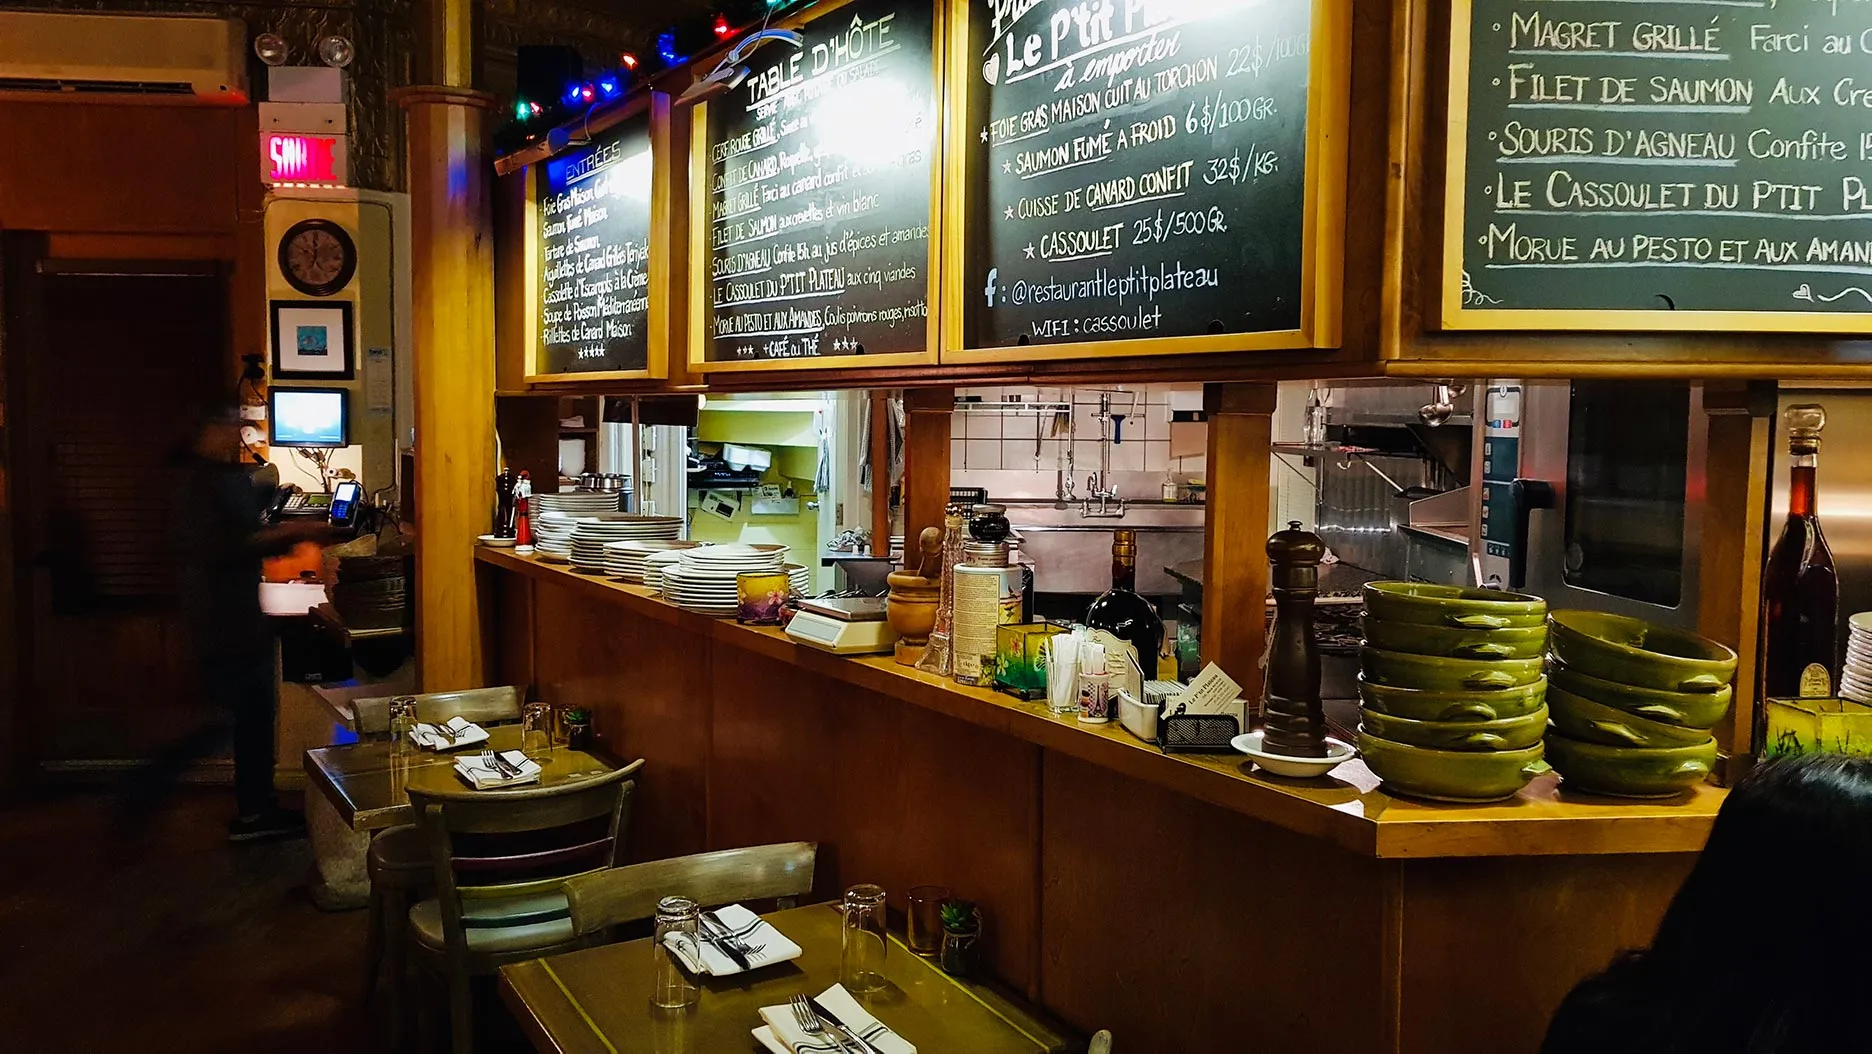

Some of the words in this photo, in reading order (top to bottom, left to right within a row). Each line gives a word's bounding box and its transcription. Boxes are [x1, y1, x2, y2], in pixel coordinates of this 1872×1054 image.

[1005, 32, 1042, 77] Le
[1509, 11, 1622, 51] MAGRET
[1631, 15, 1722, 52] GRILLÉ
[1750, 24, 1809, 53] Farci
[1822, 35, 1852, 55] au
[746, 52, 804, 104] TABLE
[811, 12, 896, 77] D'HÔTE
[1055, 61, 1076, 91] à
[1078, 31, 1181, 88] emporter
[991, 120, 1018, 142] FOIE
[1020, 103, 1050, 131] GRAS
[1051, 91, 1102, 124] MAISON
[1104, 78, 1134, 109] CUIT
[1134, 76, 1152, 102] AU
[1153, 54, 1218, 94] TORCHON
[1508, 62, 1591, 102] FILET
[1599, 77, 1638, 103] DE
[1649, 77, 1753, 106] SAUMON
[1769, 81, 1820, 106] Aux
[565, 140, 621, 181] ENTRÉES
[1015, 140, 1069, 175] SAUMON
[1073, 118, 1115, 161] FUMÉ
[1130, 113, 1177, 147] FROID
[1498, 119, 1594, 156] SOURIS
[1604, 129, 1736, 160] D'AGNEAU
[1747, 127, 1848, 162] Confite
[738, 164, 749, 183] DE
[1017, 193, 1059, 220] CUISSE
[1064, 187, 1083, 213] DE
[1085, 174, 1136, 210] CANARD
[1138, 160, 1194, 195] CONFIT
[1497, 171, 1532, 209] LE
[1545, 169, 1697, 212] CASSOULET
[1704, 183, 1740, 211] DU
[712, 226, 734, 248] FILET
[735, 221, 745, 242] DE
[836, 195, 851, 217] vin
[853, 188, 880, 213] blanc
[712, 254, 737, 277] SOURIS
[811, 244, 823, 259] au
[823, 236, 838, 263] jus
[839, 229, 877, 258] d'épices
[878, 225, 891, 247] et
[891, 218, 930, 244] amandes
[1040, 222, 1126, 260] CASSOULET
[1487, 221, 1579, 261] MORUE
[1590, 238, 1625, 262] AU
[1632, 234, 1713, 263] PESTO
[1719, 238, 1749, 262] ET
[1754, 238, 1799, 263] AUX
[575, 254, 584, 274] de
[713, 286, 724, 305] LE
[766, 281, 778, 297] DU
[808, 265, 846, 292] PLATEAU
[846, 272, 862, 287] aux
[863, 266, 883, 291] cinq
[883, 261, 916, 283] viandes
[1012, 259, 1220, 307] @restaurantleptitplateau
[543, 308, 564, 328] Soupe
[563, 303, 573, 322] de
[571, 324, 580, 341] de
[580, 321, 604, 341] Canard
[713, 316, 734, 338] MORUE
[734, 314, 744, 333] AU
[743, 311, 763, 333] PESTO
[763, 312, 773, 331] ET
[1082, 304, 1163, 334] cassoulet
[801, 333, 821, 356] THÉ
